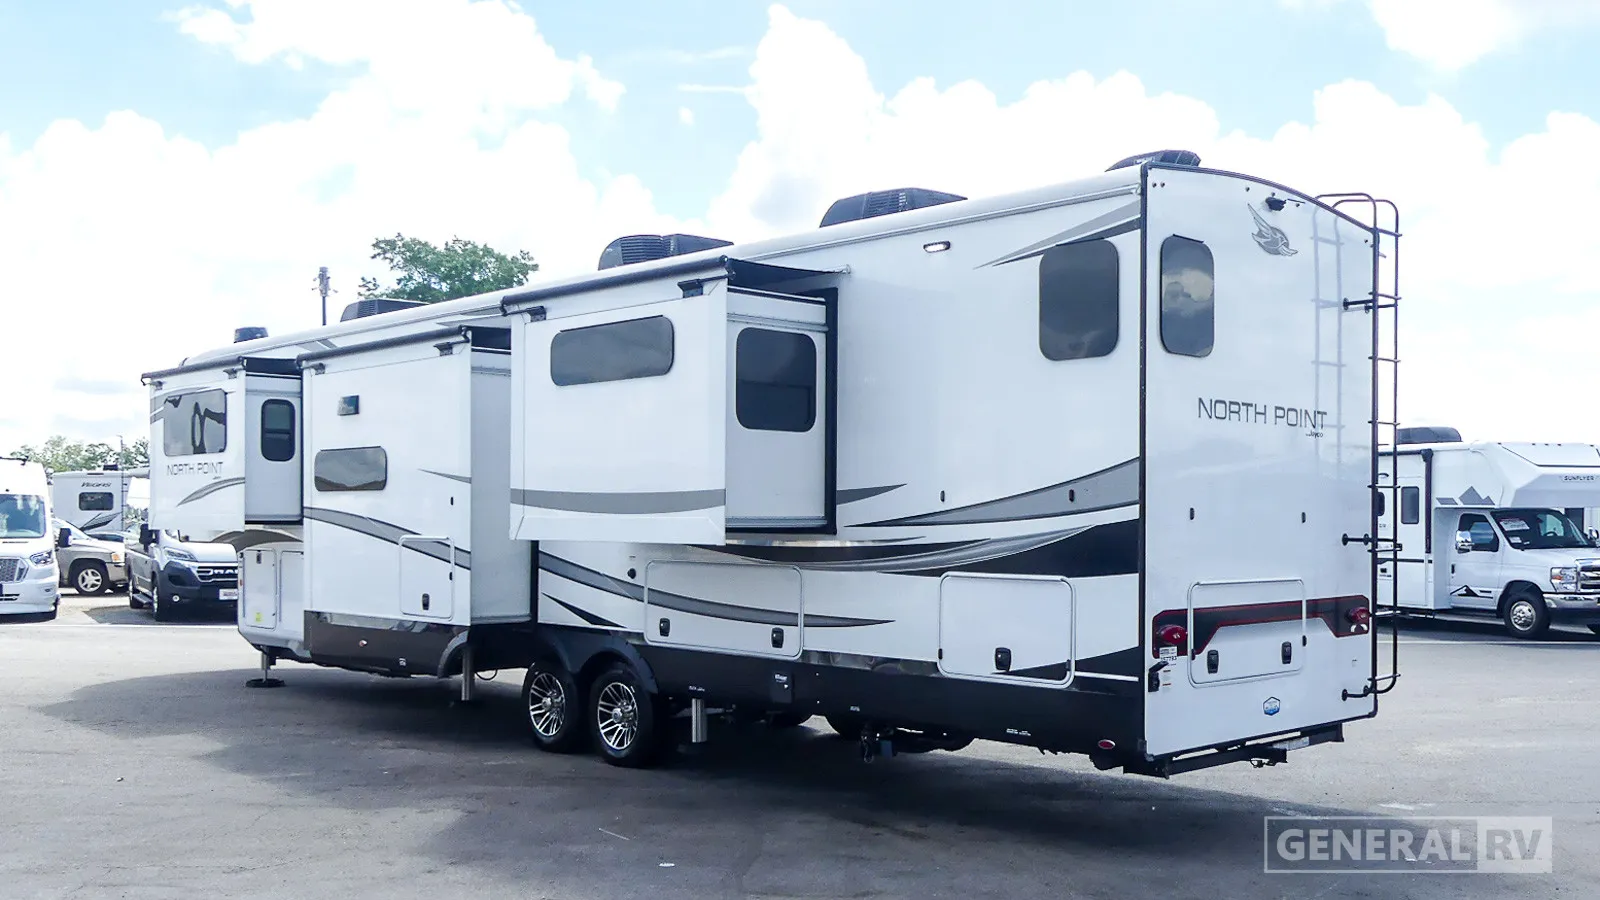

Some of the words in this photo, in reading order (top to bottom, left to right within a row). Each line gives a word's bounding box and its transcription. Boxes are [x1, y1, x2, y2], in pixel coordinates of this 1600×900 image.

[1198, 397, 1266, 424] NORTH
[1274, 406, 1327, 429] POINT
[167, 463, 194, 476] NORTH
[197, 461, 223, 474] POINT
